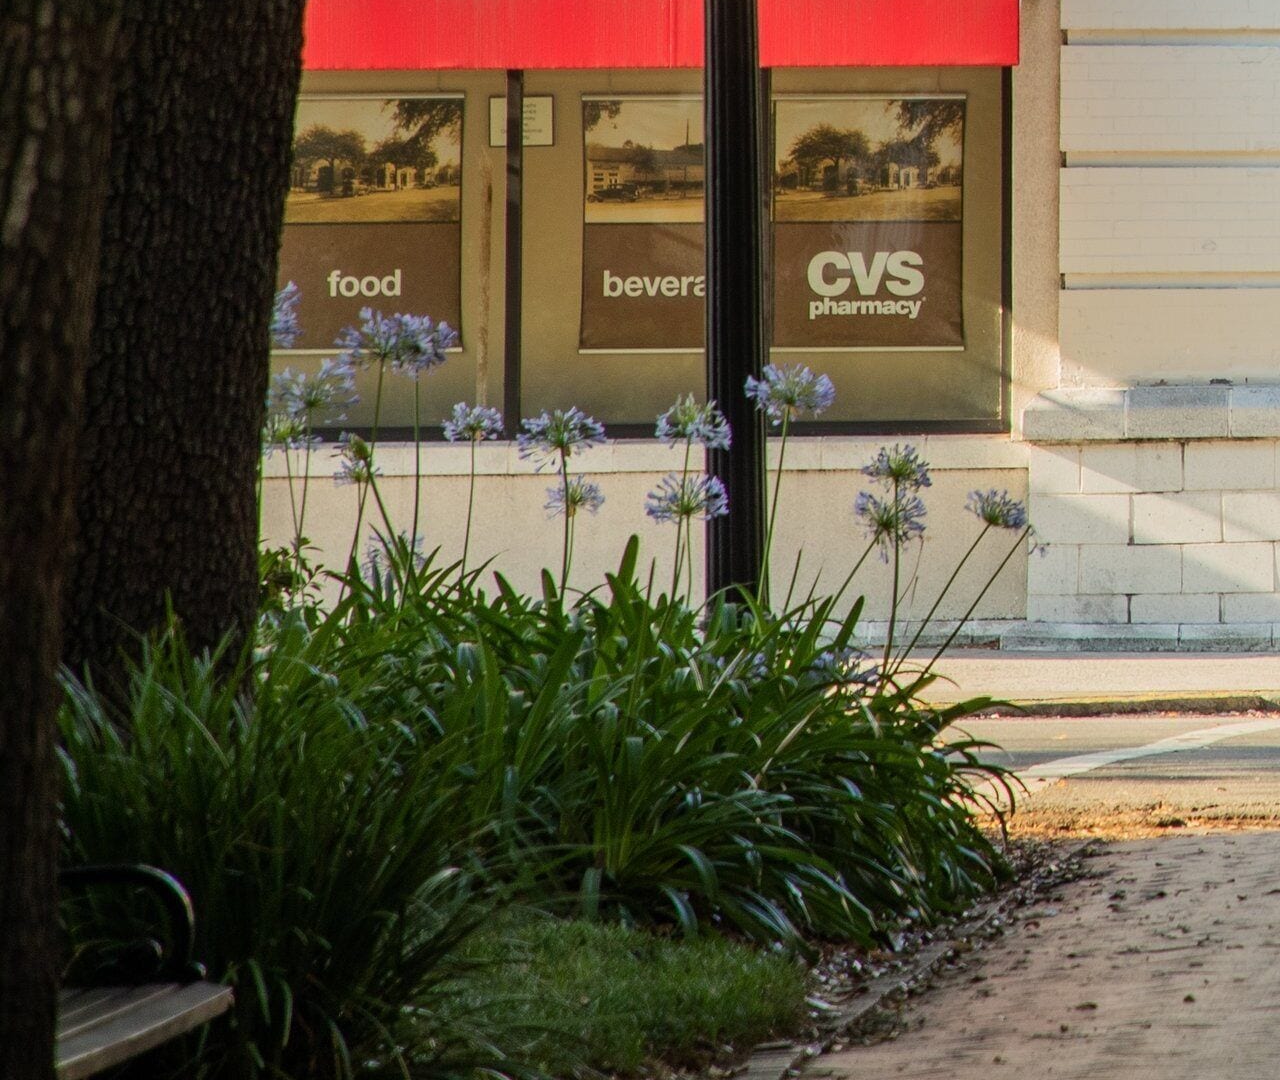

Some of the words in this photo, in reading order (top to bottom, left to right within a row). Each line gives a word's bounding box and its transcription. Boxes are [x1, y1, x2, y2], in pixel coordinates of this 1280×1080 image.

[326, 268, 402, 297] food
[807, 250, 926, 297] CVS
[809, 297, 922, 320] pharmacy
